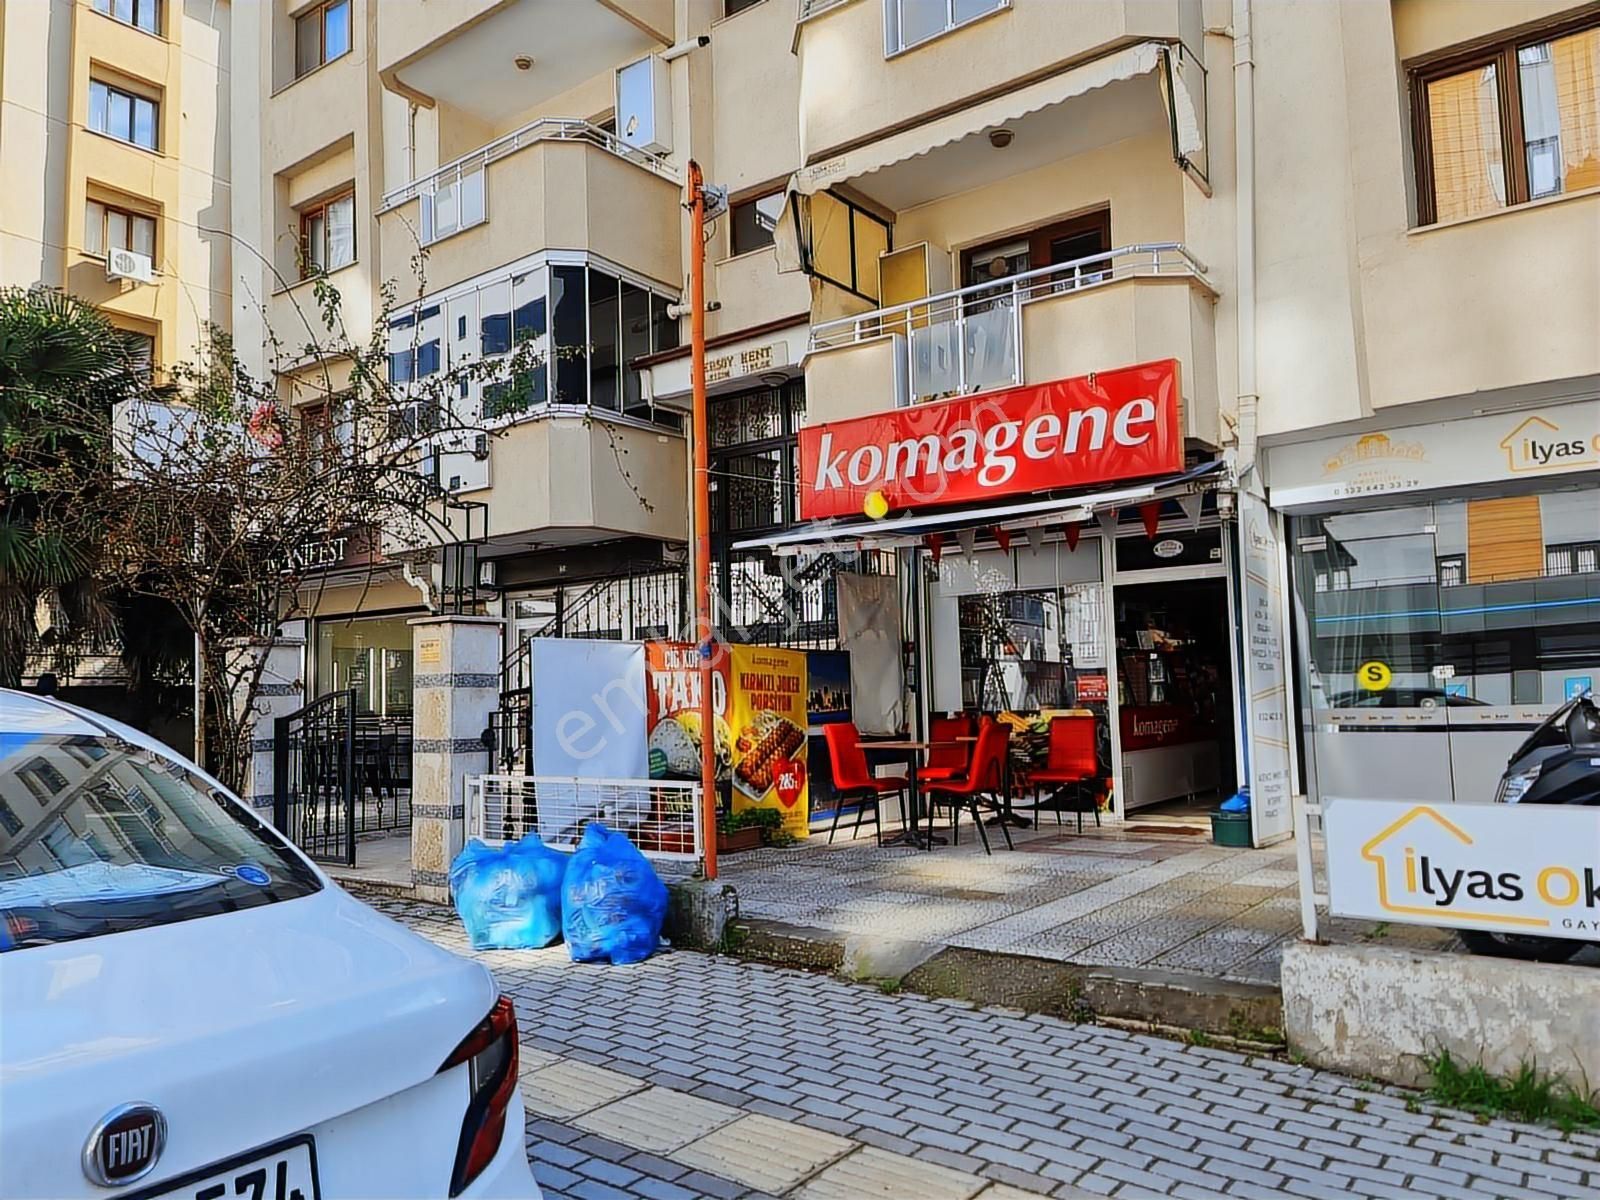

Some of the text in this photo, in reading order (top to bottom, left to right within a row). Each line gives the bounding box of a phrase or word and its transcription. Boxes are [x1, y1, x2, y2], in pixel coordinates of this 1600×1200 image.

[741, 346, 772, 364] KENT
[815, 397, 1155, 487] komagene
[108, 1124, 152, 1169] FIAT
